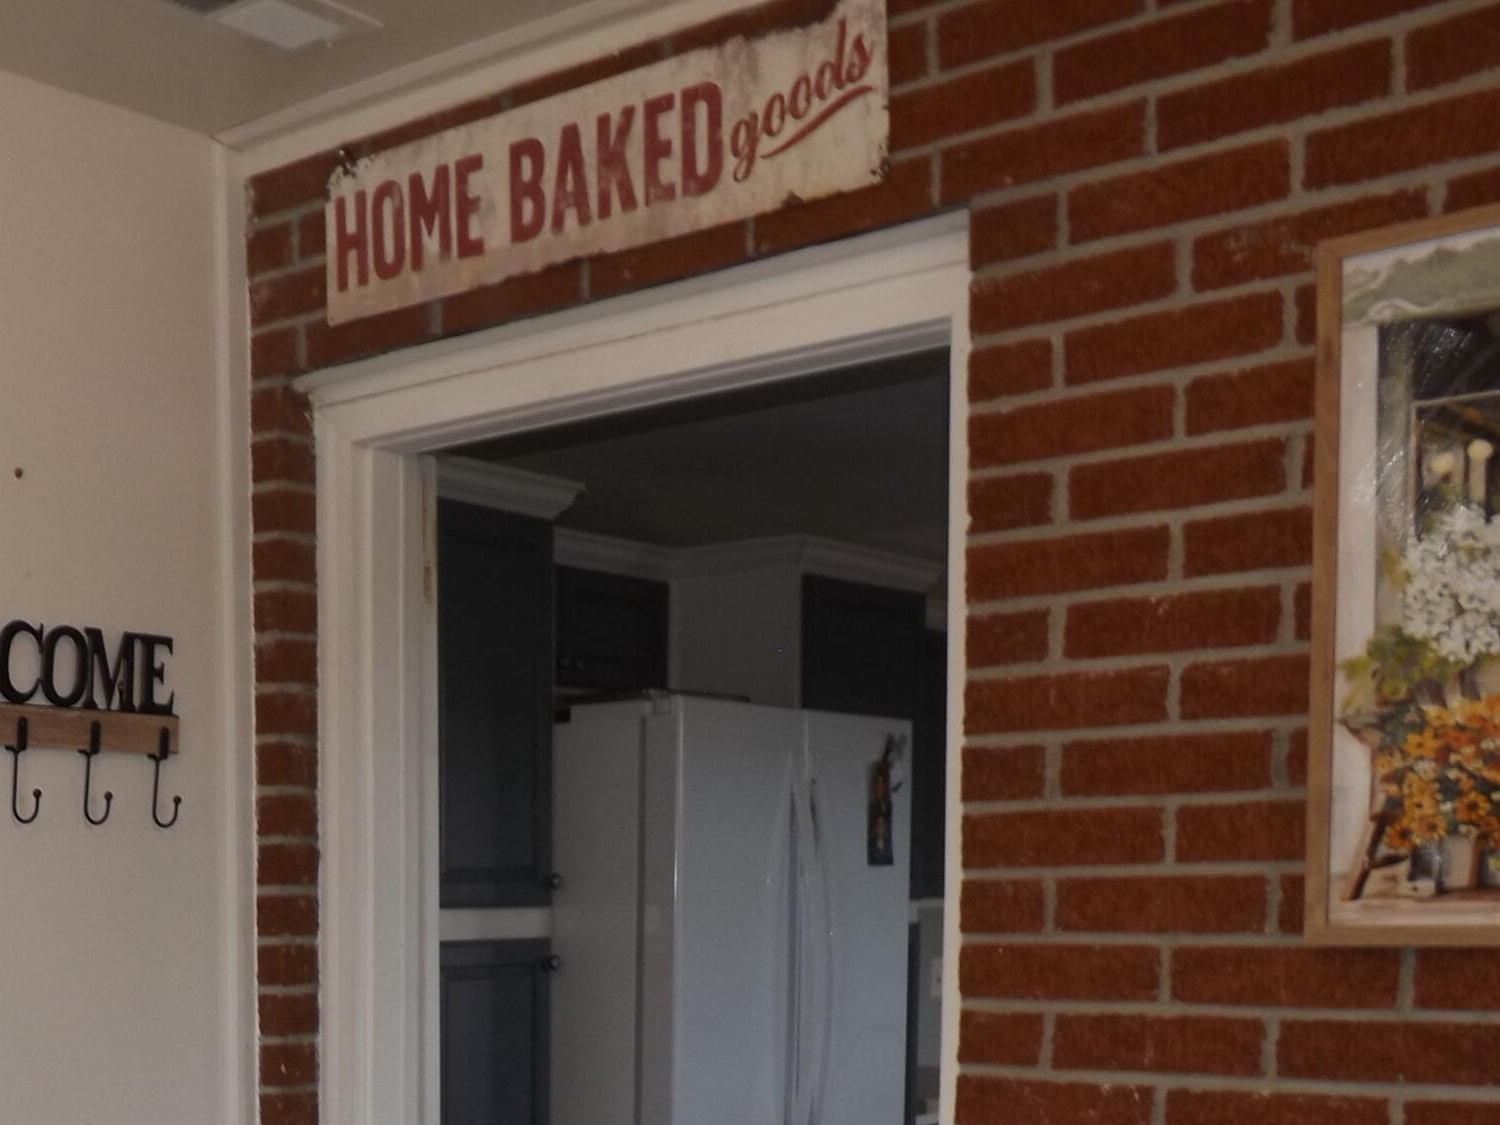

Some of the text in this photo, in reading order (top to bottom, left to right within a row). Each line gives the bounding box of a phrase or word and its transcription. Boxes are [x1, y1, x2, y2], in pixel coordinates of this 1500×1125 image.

[334, 17, 874, 293] HOME BAKED goods
